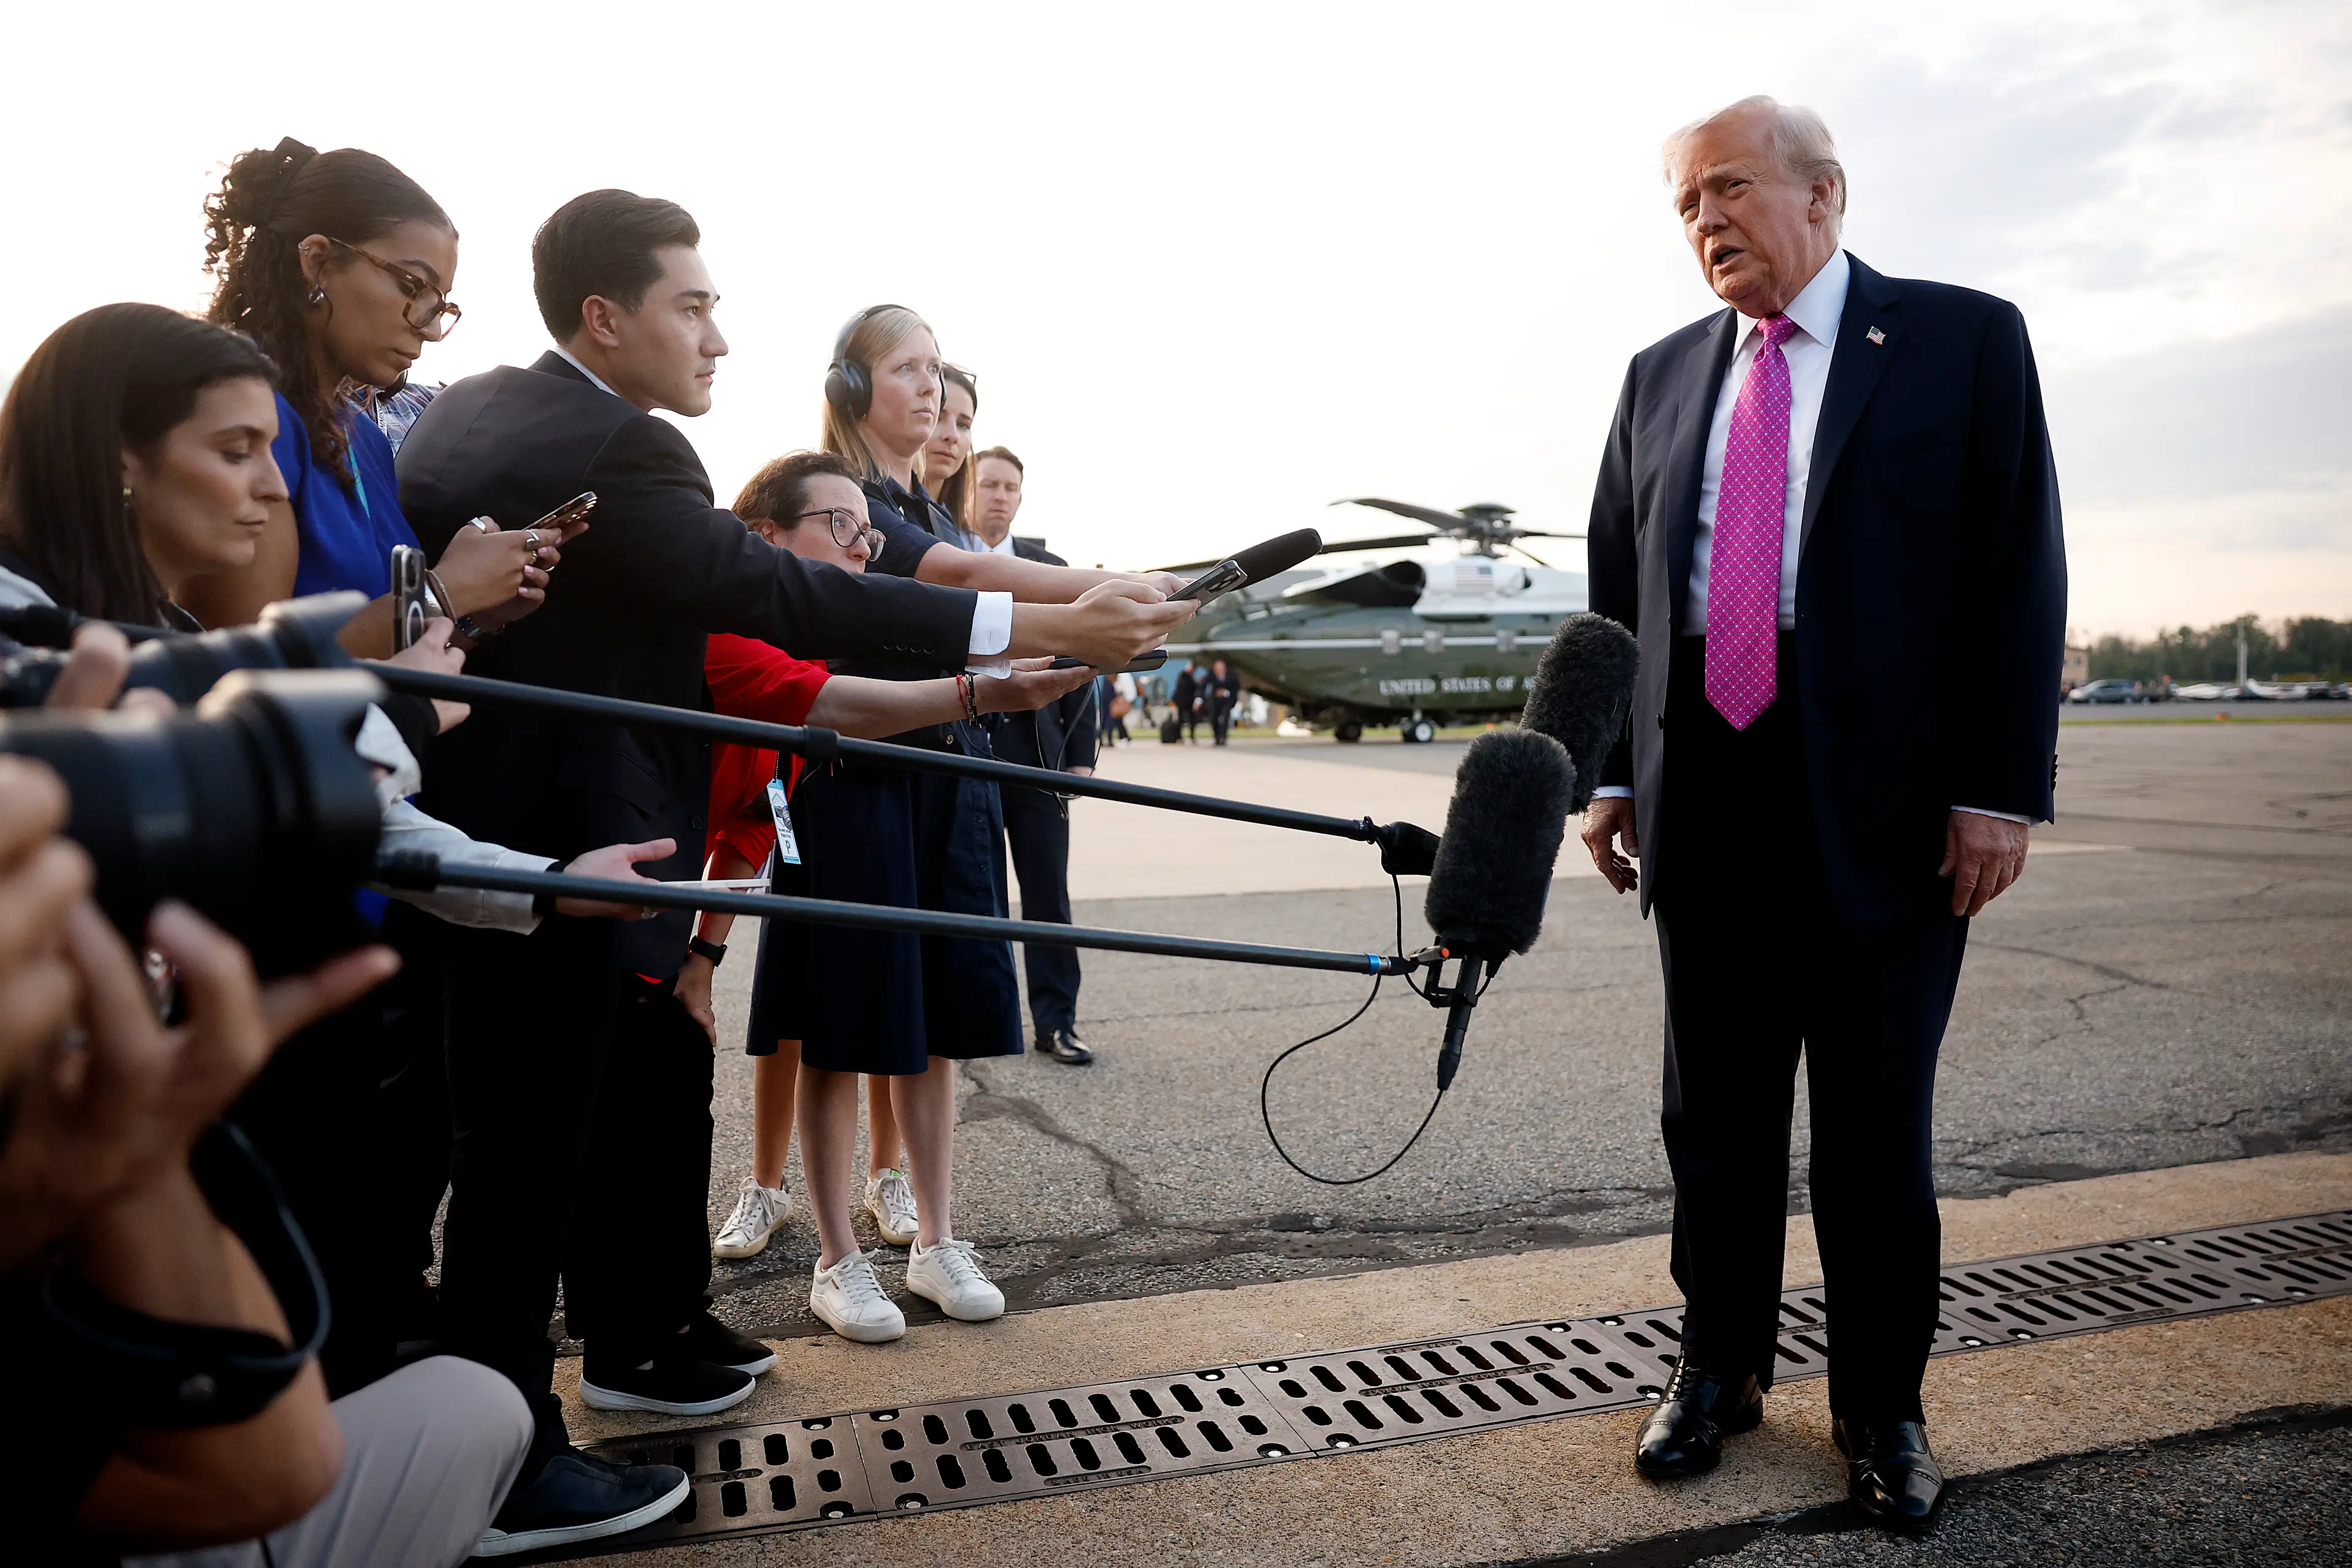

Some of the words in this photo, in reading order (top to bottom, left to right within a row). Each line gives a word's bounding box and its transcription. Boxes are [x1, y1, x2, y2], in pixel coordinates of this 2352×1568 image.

[1379, 678, 1436, 695] UNITED
[1441, 677, 1491, 693] STATES
[1496, 676, 1516, 692] OF
[785, 840, 791, 854] P
[967, 1439, 1005, 1451] EAST
[1016, 1431, 1076, 1444] JORDAN
[1085, 1425, 1121, 1435] IRON
[1129, 1417, 1180, 1430] WORKS
[1051, 1475, 1090, 1487] MADE
[1097, 1471, 1111, 1480] IN
